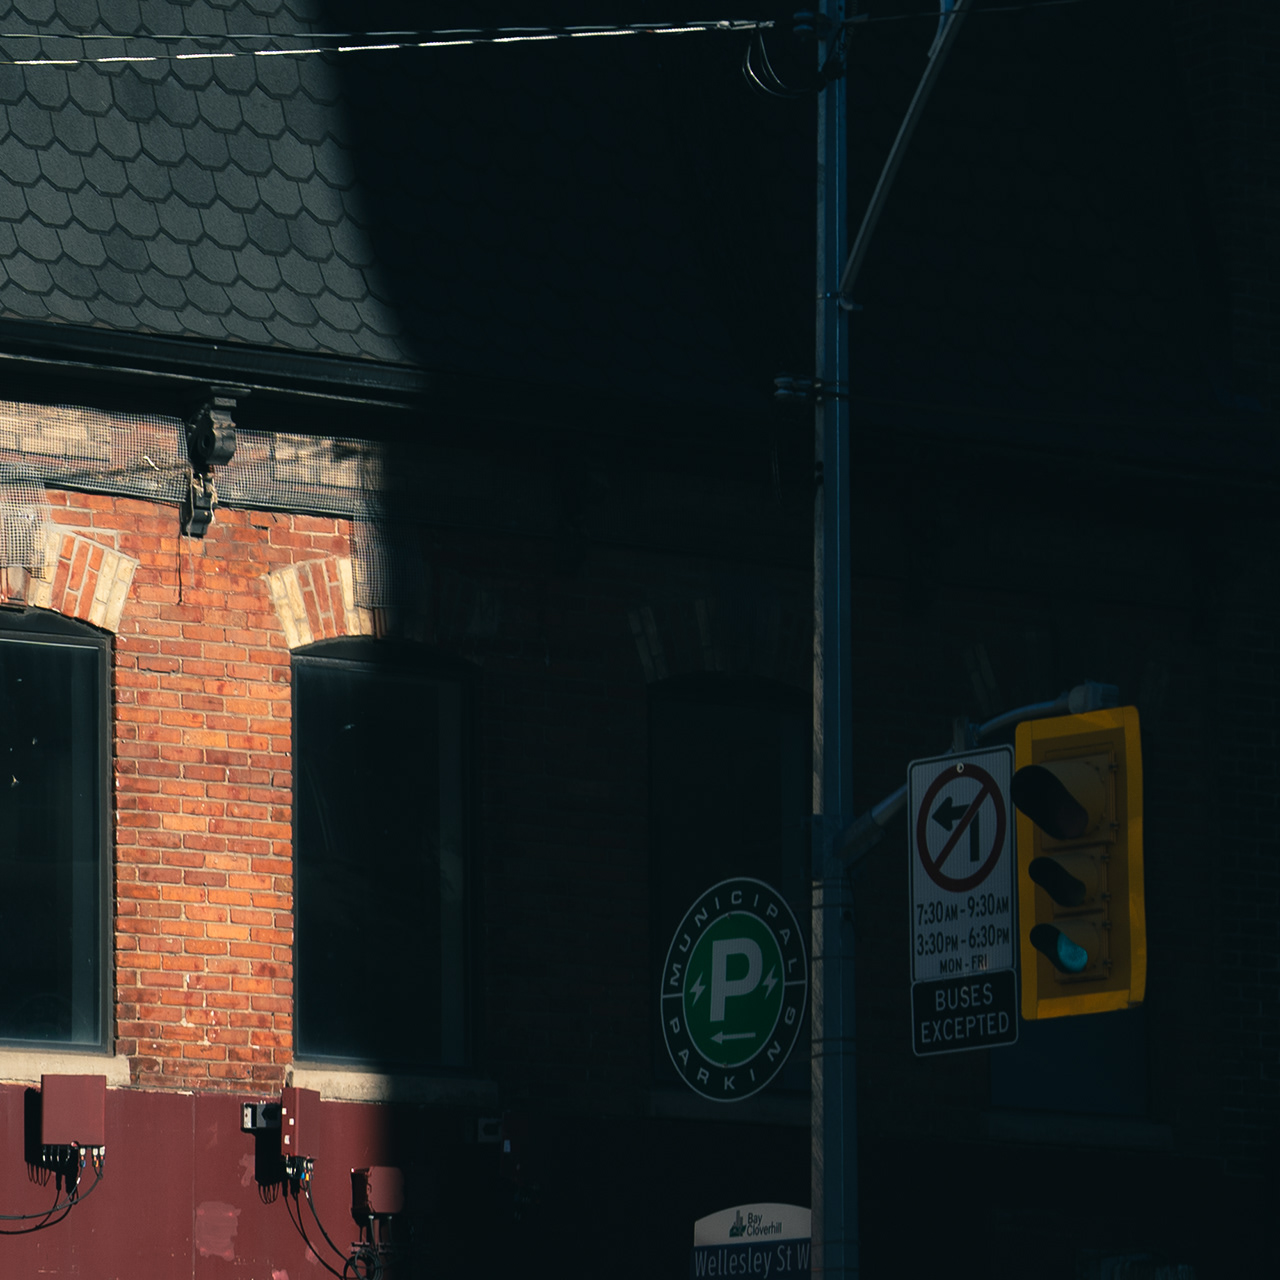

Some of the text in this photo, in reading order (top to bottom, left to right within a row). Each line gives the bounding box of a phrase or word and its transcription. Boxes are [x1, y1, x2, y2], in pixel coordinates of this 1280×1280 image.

[669, 890, 798, 986] MUNICIPAL
[709, 937, 763, 1022] P
[940, 954, 988, 974] MON FRI
[935, 983, 993, 1012] BUSES
[921, 1011, 1010, 1043] EXCEPTED
[669, 1006, 796, 1091] PARKING
[746, 1221, 782, 1237] Cloverhill
[747, 1212, 763, 1225] Bay
[694, 1242, 810, 1280] Wellesley St W
